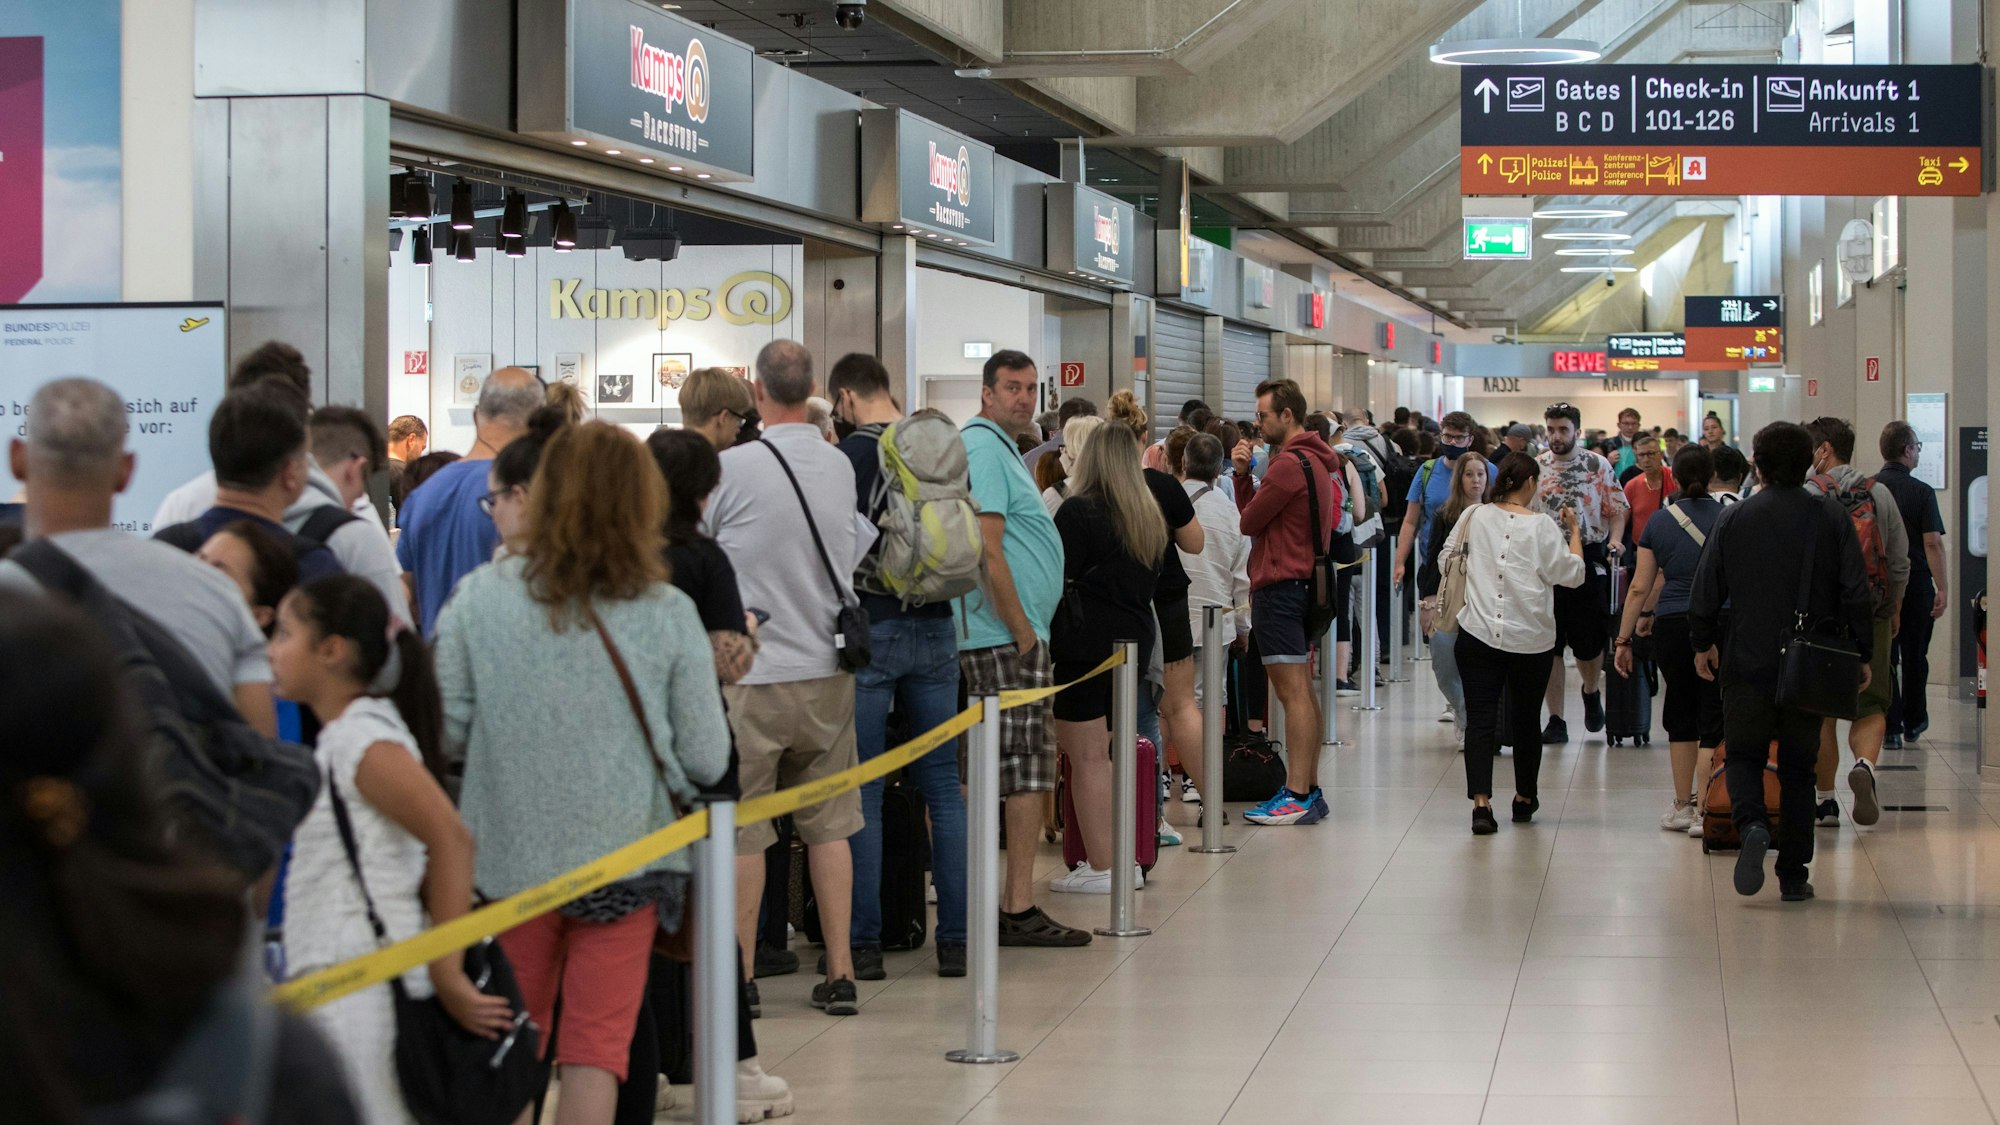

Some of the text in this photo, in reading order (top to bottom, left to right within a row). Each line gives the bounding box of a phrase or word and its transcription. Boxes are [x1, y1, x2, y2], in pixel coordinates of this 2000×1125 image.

[630, 24, 685, 114] Kamps
[1555, 79, 1621, 101] Gates
[1645, 77, 1744, 100] Check-in
[1809, 79, 1920, 101] Ankunft 1
[1556, 111, 1614, 132] B C D
[1645, 109, 1735, 131] 101-126
[1809, 111, 1920, 133] Arrivals 1
[643, 111, 698, 153] BACKSTUBE
[1531, 157, 1568, 168] Polizei
[1603, 153, 1645, 162] Konferenz-
[1919, 156, 1941, 167] Taxi
[929, 140, 958, 202] Kamps
[1531, 170, 1562, 181] Police
[1603, 171, 1645, 180] Conference
[550, 278, 712, 331] Kamps
[1553, 351, 1607, 372] REWE
[126, 397, 198, 414] sich auf
[139, 421, 173, 434] vor:
